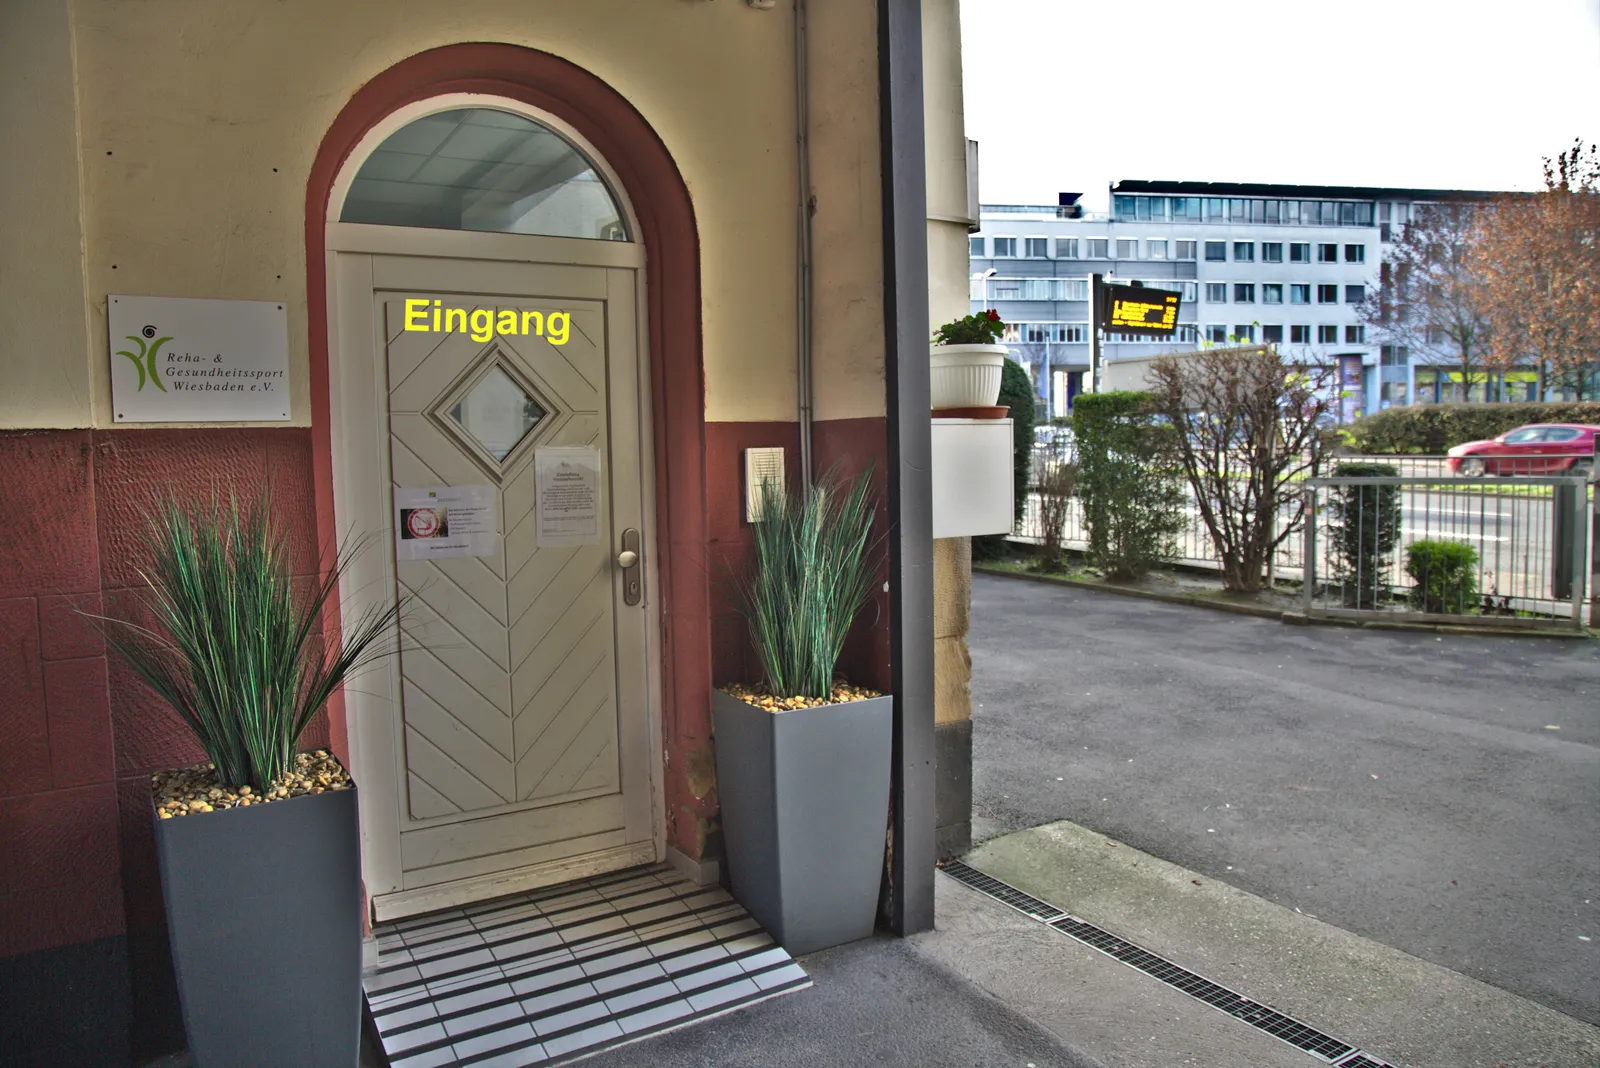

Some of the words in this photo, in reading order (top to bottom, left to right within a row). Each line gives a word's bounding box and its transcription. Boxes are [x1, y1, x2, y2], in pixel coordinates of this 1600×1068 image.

[404, 298, 571, 345] Eingang
[167, 352, 207, 363] Reha-
[213, 354, 224, 364] &
[165, 366, 284, 380] Gesundheitssport
[173, 381, 245, 391] Wiesbaden
[250, 382, 275, 392] e.V.
